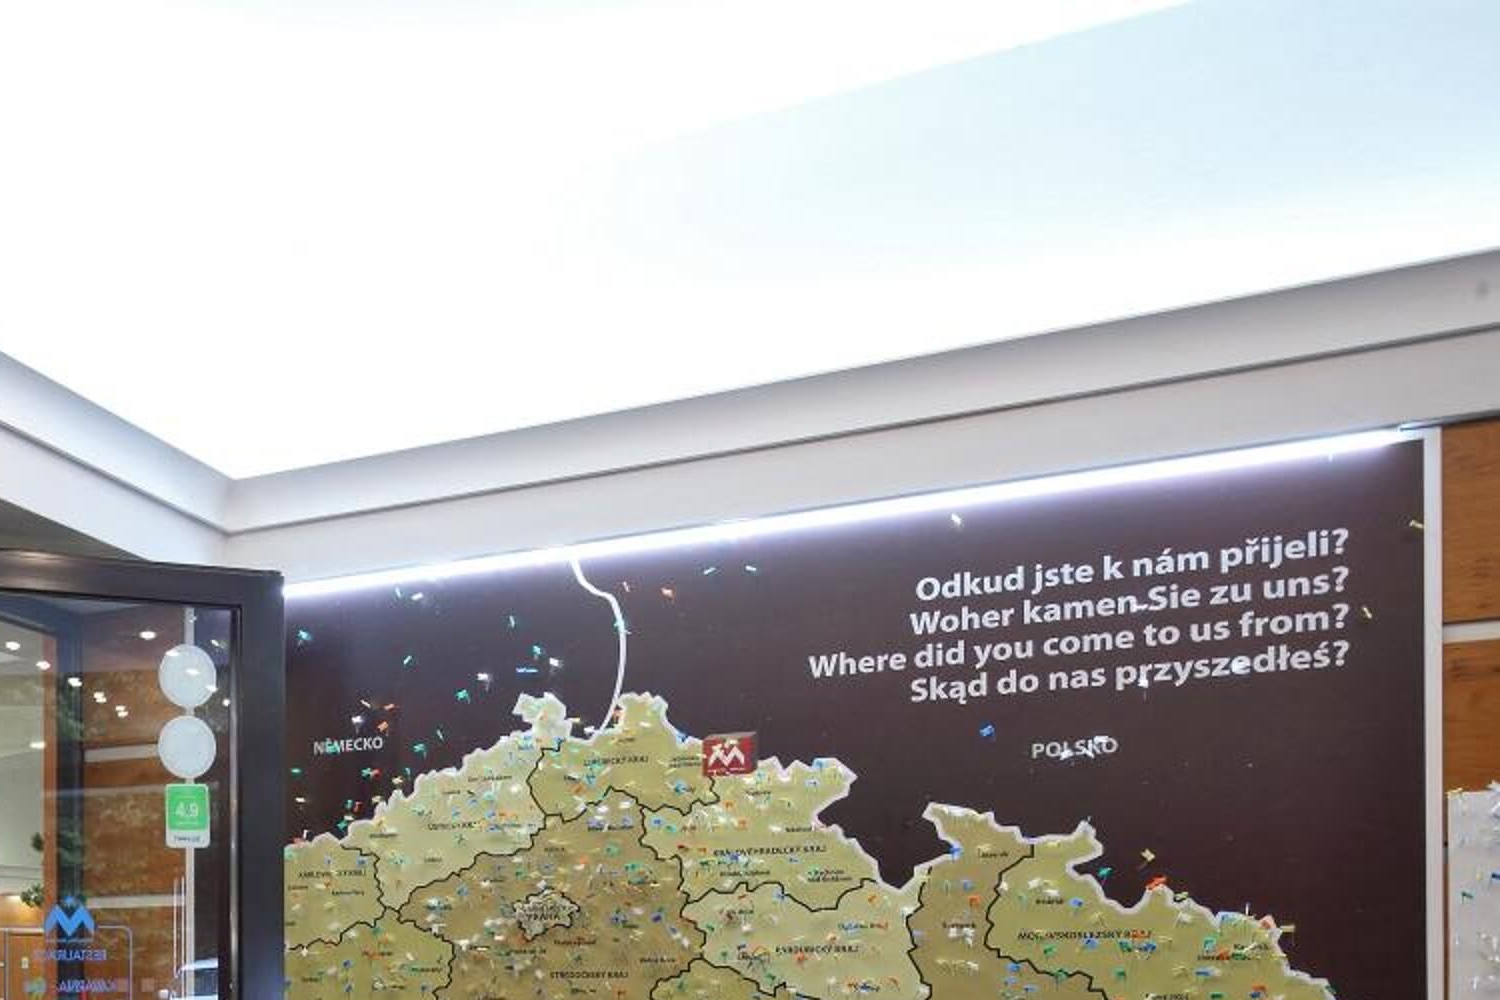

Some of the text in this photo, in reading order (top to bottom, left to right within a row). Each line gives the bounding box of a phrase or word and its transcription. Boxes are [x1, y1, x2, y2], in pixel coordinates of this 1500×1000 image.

[915, 528, 1349, 601] Odkud jste k nám přijeli?
[909, 566, 1349, 635] Woher kamen Sie zu uns?
[808, 603, 1349, 679] Where did you come to us from?
[911, 640, 1349, 704] Skąd do nas przyszedłeś?
[1031, 737, 1118, 760] POLSKO
